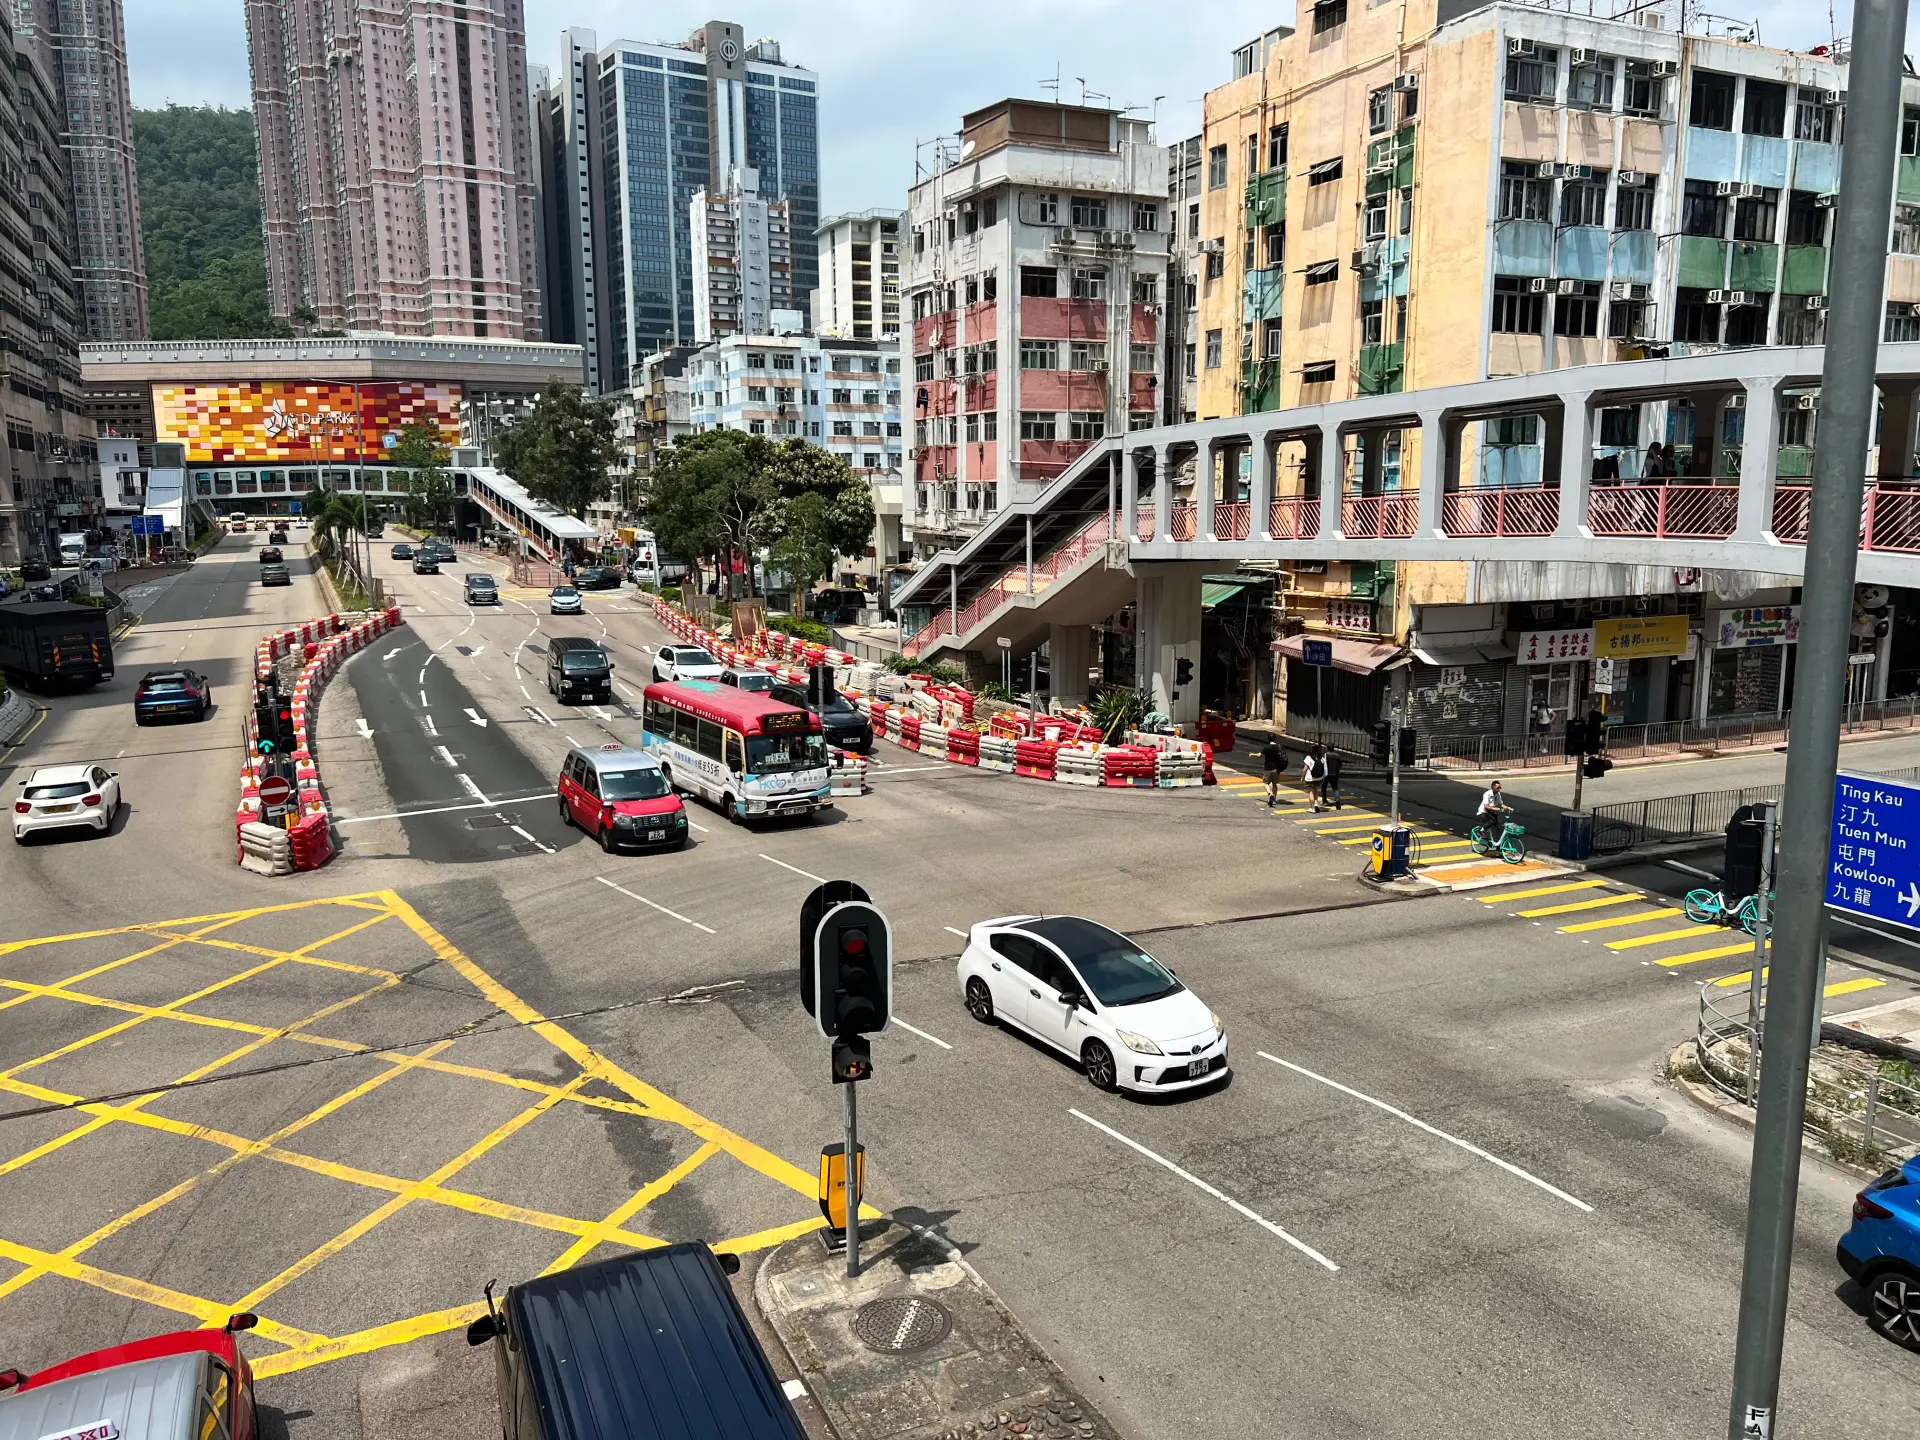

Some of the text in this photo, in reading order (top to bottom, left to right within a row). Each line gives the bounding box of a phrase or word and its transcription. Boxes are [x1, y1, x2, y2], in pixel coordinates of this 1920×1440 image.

[1841, 784, 1903, 806] Ting Kau
[1840, 804, 1879, 827] 汀九
[1837, 823, 1907, 849] Tuen Mun
[1838, 843, 1876, 866] 屯門
[1833, 862, 1896, 887] Kowloon
[1833, 882, 1871, 906] 九龍
